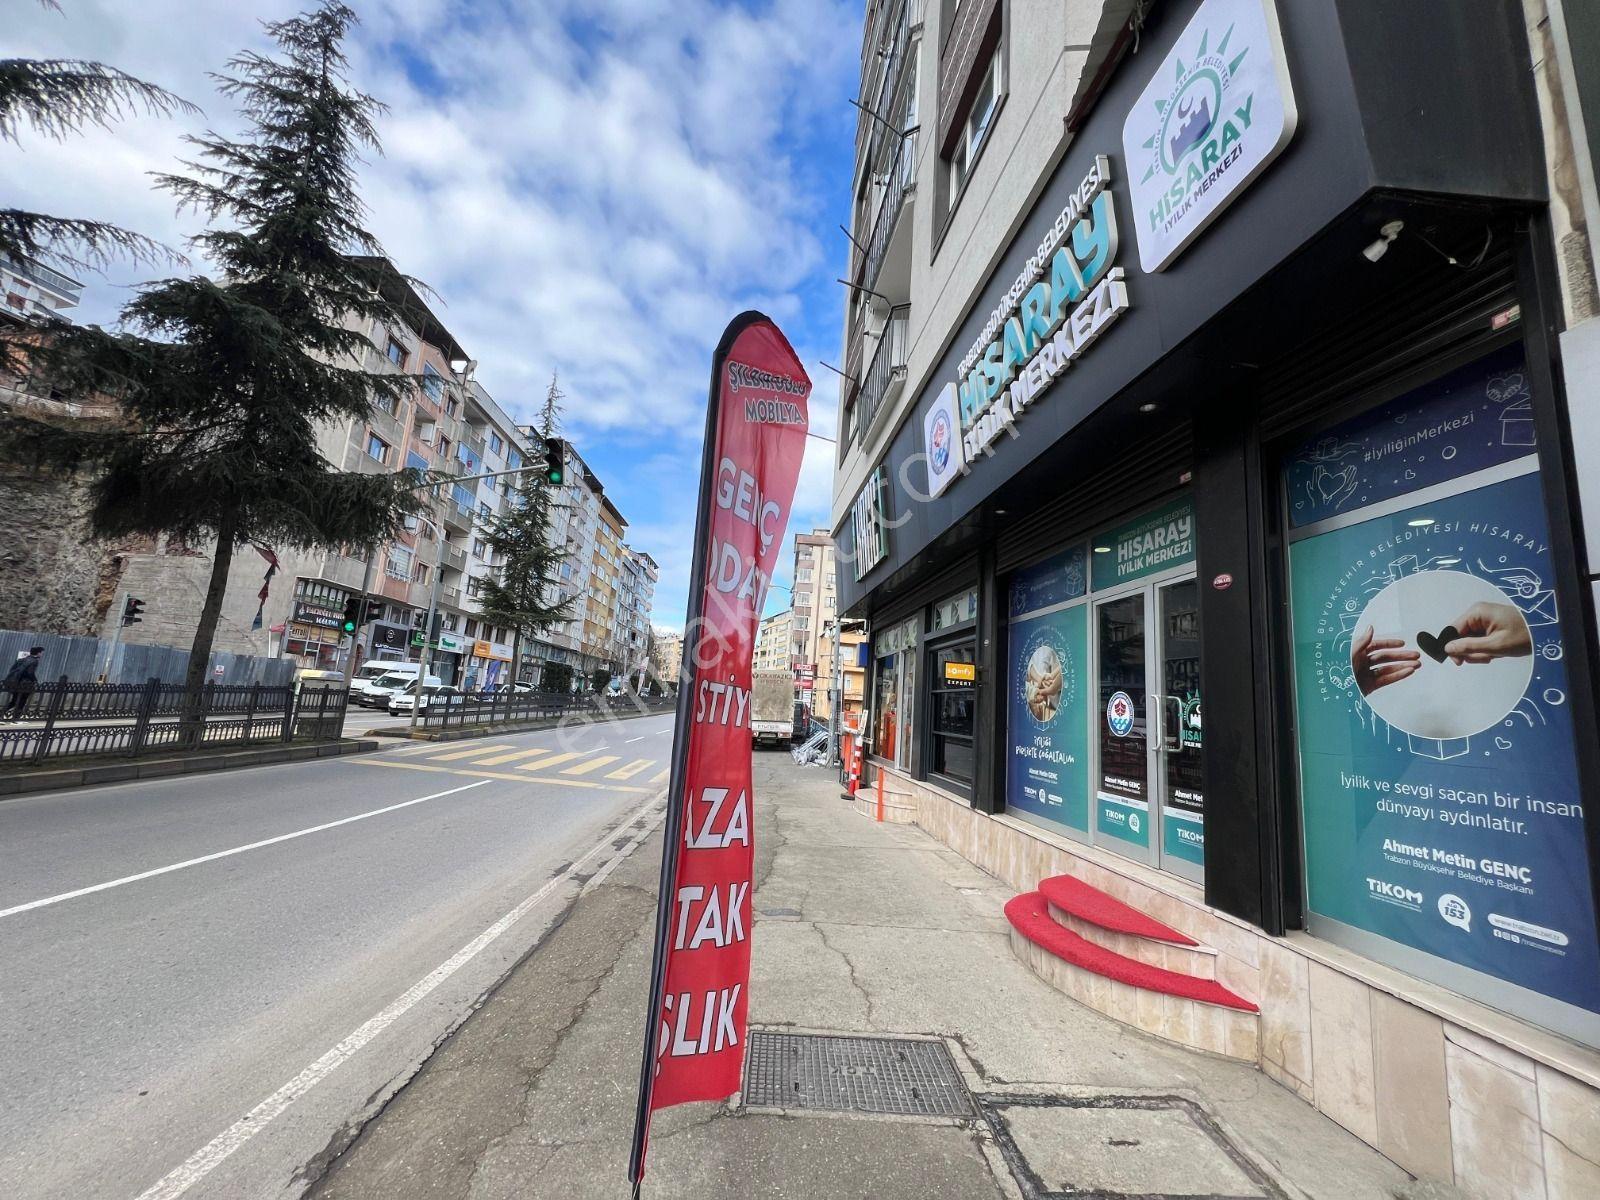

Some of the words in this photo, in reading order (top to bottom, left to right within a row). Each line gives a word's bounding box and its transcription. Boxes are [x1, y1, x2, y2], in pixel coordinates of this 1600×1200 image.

[744, 395, 807, 424] MOBİLYA
[717, 457, 780, 557] GENÇ
[1174, 790, 1192, 800] Ahmet
[1340, 771, 1370, 789] İyilik
[1374, 778, 1390, 792] ve
[1394, 782, 1433, 799] sevgi
[1438, 788, 1488, 805] saçan
[1494, 792, 1520, 809] bir
[1526, 795, 1584, 818] insan
[1376, 797, 1434, 820] dünyayı
[1439, 809, 1528, 835] aydınlatır.
[1383, 838, 1430, 860] Ahmet
[1432, 848, 1476, 870] Metin
[1480, 858, 1533, 885] GENÇ
[1383, 853, 1411, 866] Trabzon
[1413, 859, 1456, 876] Büyükşehir
[1458, 869, 1495, 886] Belediye
[1497, 879, 1534, 896] Başkanı
[1444, 906, 1465, 920] 153
